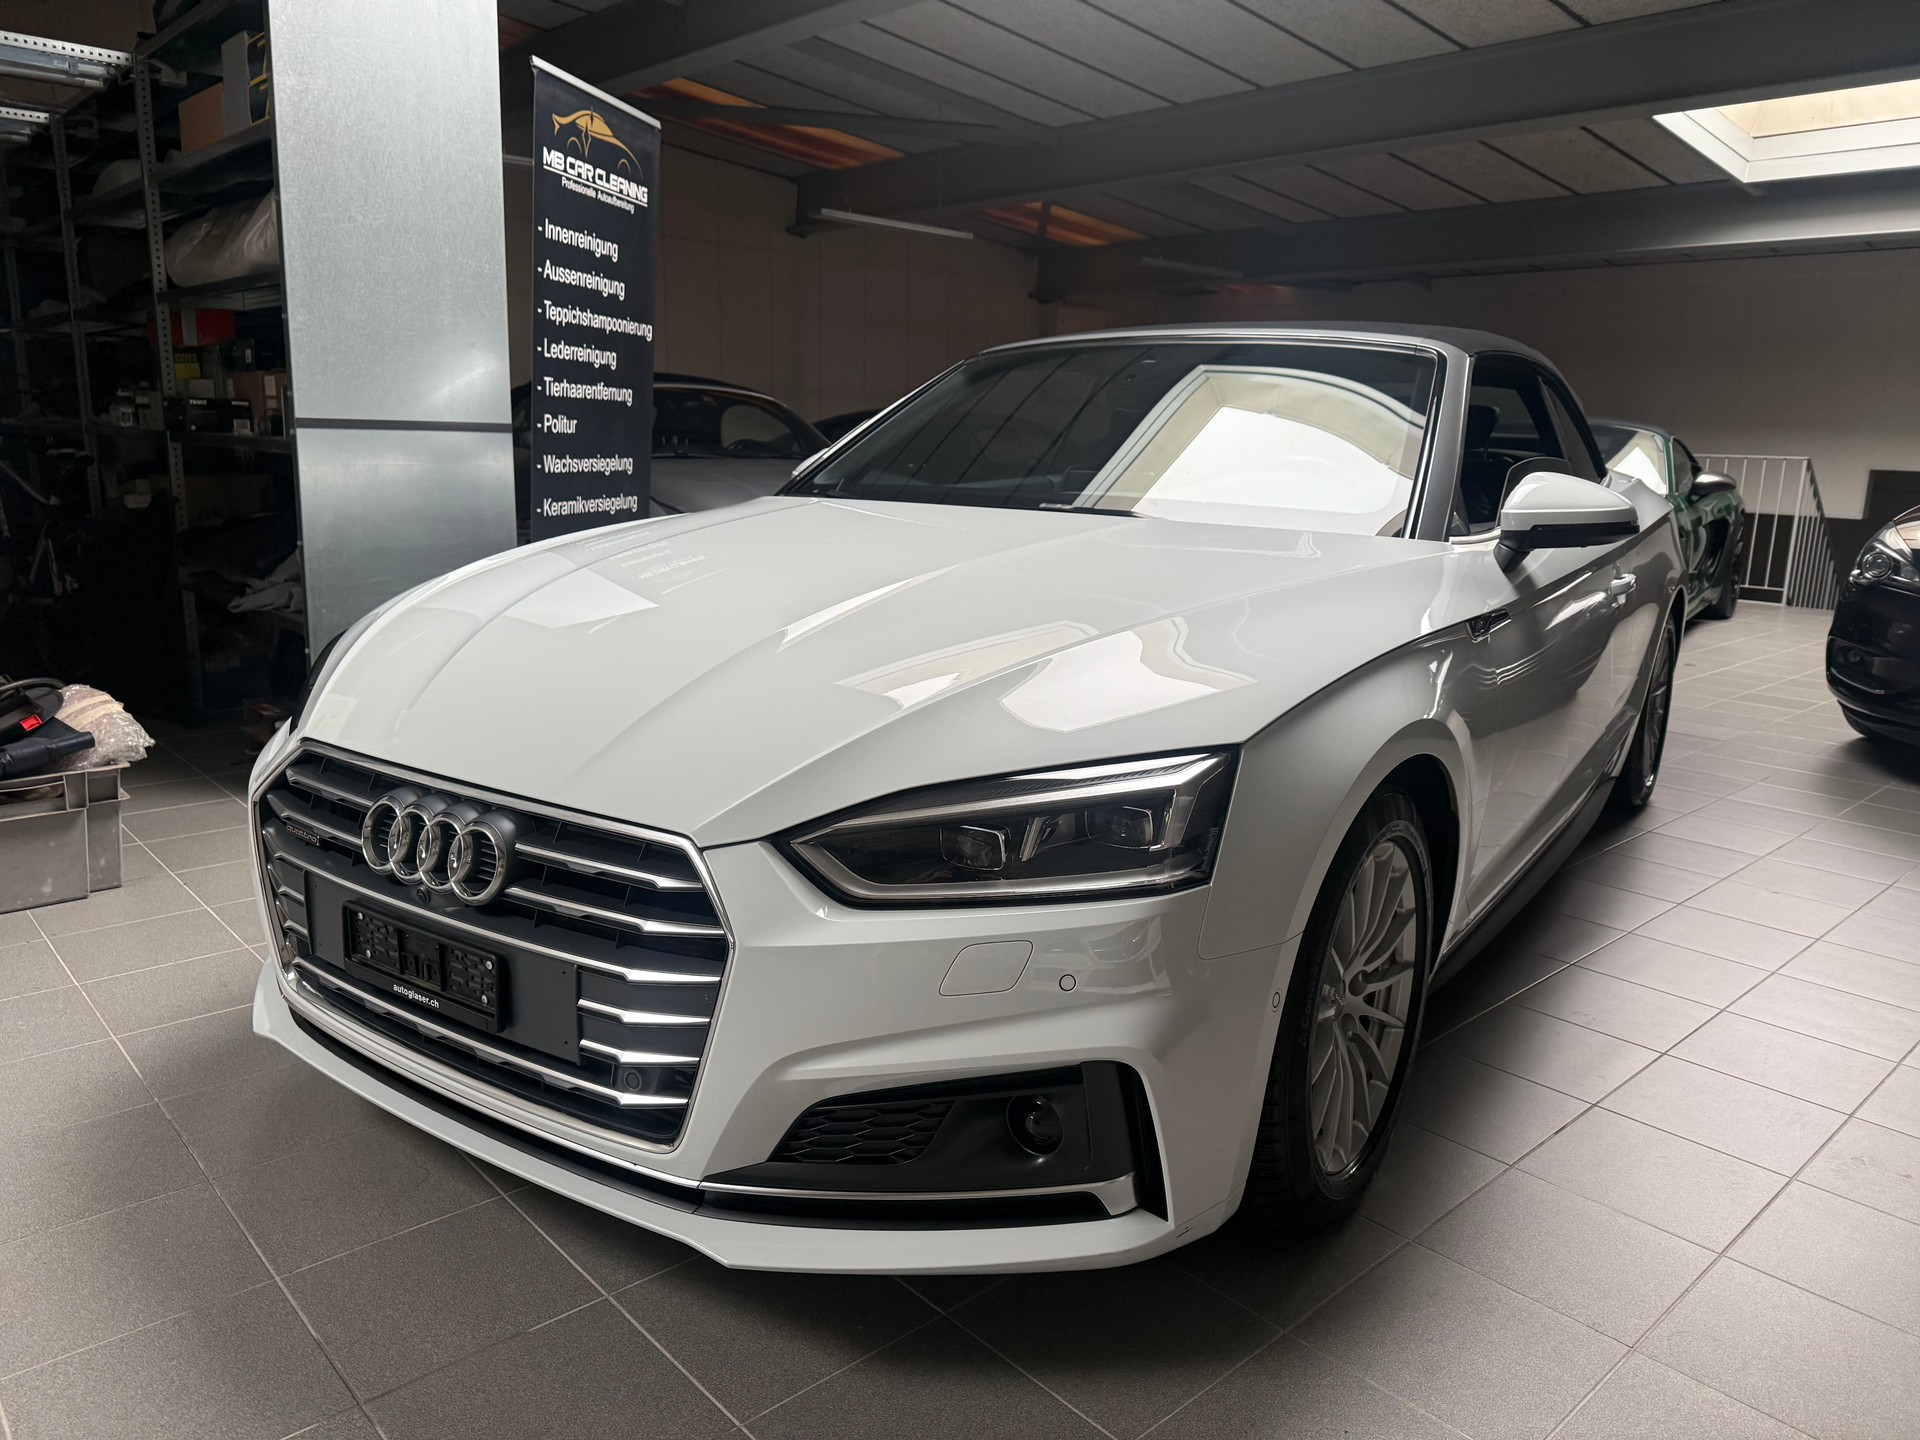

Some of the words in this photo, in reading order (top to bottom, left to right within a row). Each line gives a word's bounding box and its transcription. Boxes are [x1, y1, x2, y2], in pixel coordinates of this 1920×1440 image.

[543, 146, 565, 171] MB
[566, 156, 594, 182] CAR
[595, 167, 648, 203] CLEANING
[545, 218, 618, 262] Innenreinigung
[544, 259, 625, 301] Aussenreinigung
[544, 300, 653, 342] Teppichshampoonierung
[544, 337, 617, 370] Lederreinigung
[544, 376, 633, 407] Tierhaarentfernung
[543, 413, 578, 434] Politur
[543, 453, 634, 476] Wachsversiegelung
[543, 493, 638, 518] Keramikversiegelung
[392, 984, 440, 1009] autoglaser.ch
